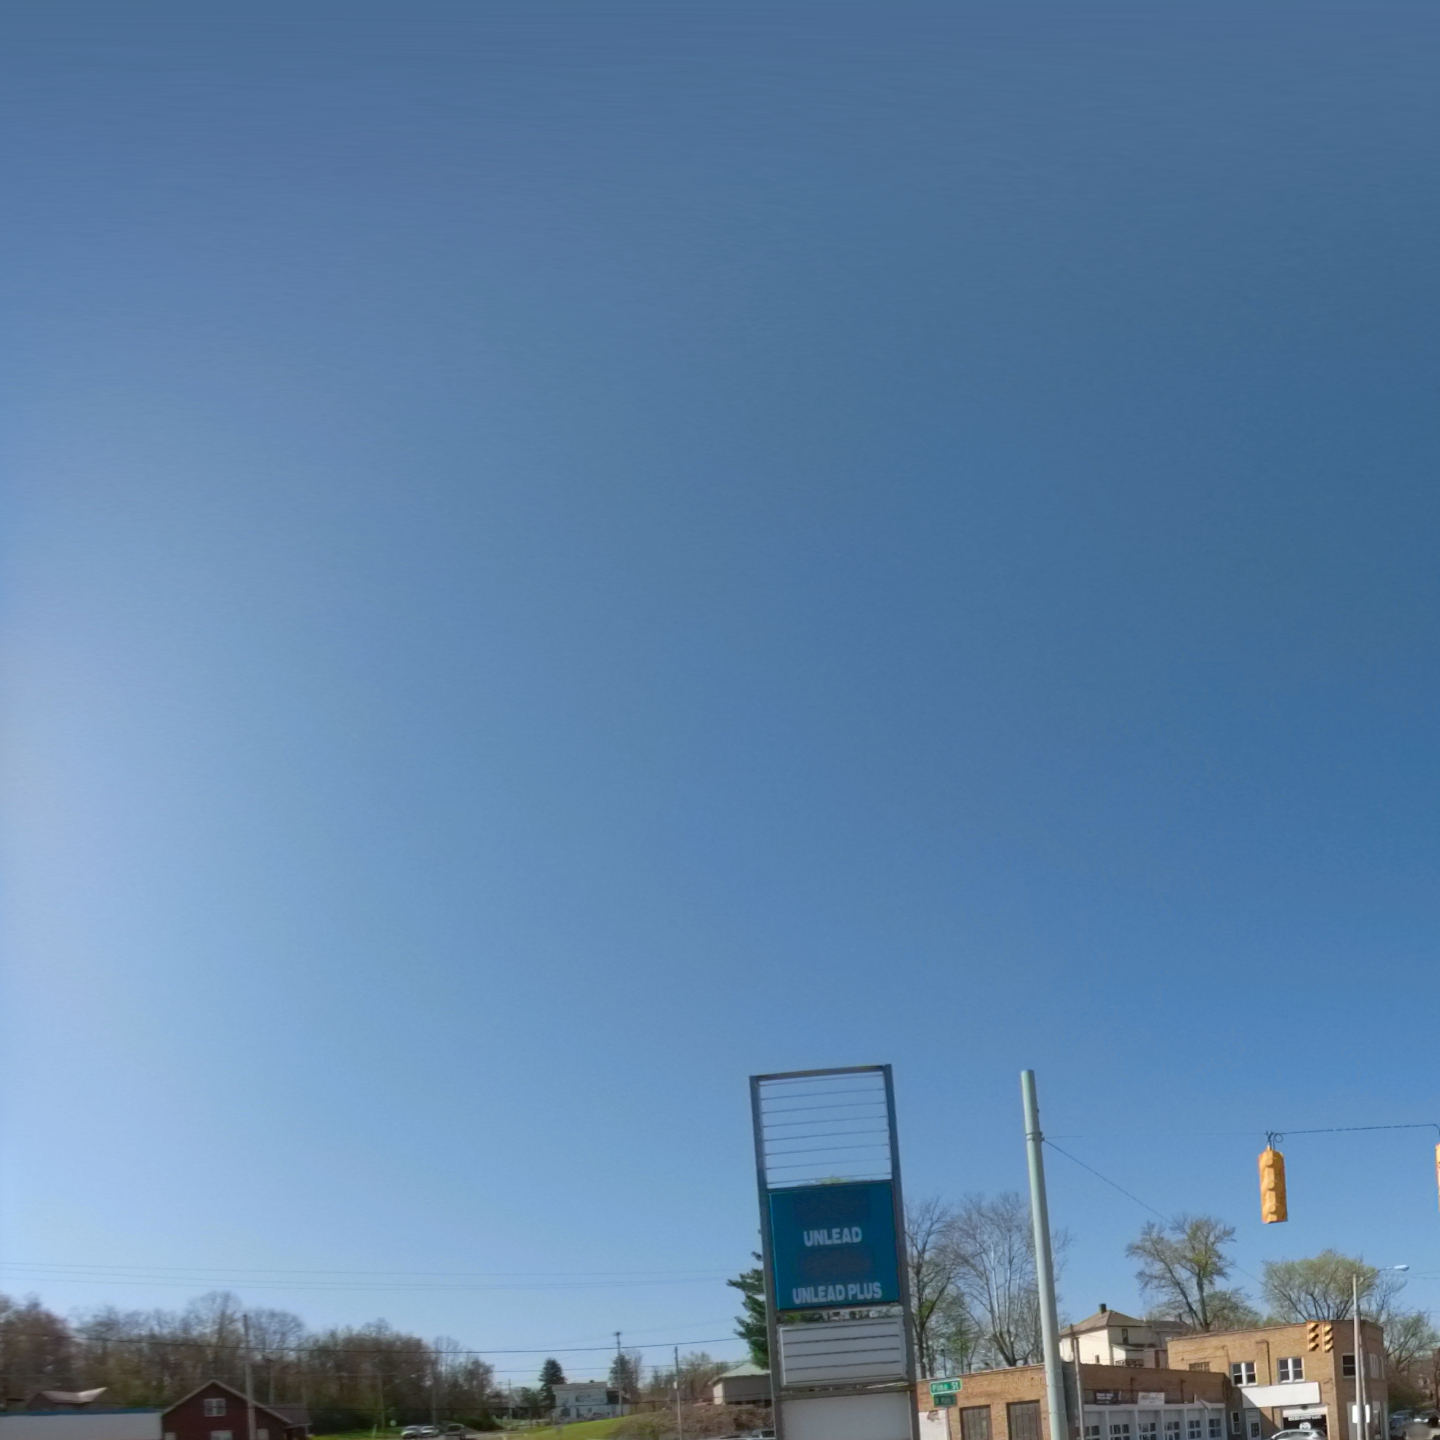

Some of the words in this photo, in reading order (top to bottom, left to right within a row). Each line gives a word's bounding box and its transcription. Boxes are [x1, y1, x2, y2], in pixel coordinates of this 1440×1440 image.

[803, 1227, 862, 1246] UNLEAD
[792, 1284, 845, 1304] UNLEAD
[848, 1282, 882, 1300] PLUS
[932, 1383, 948, 1392] Pine
[951, 1381, 959, 1389] St
